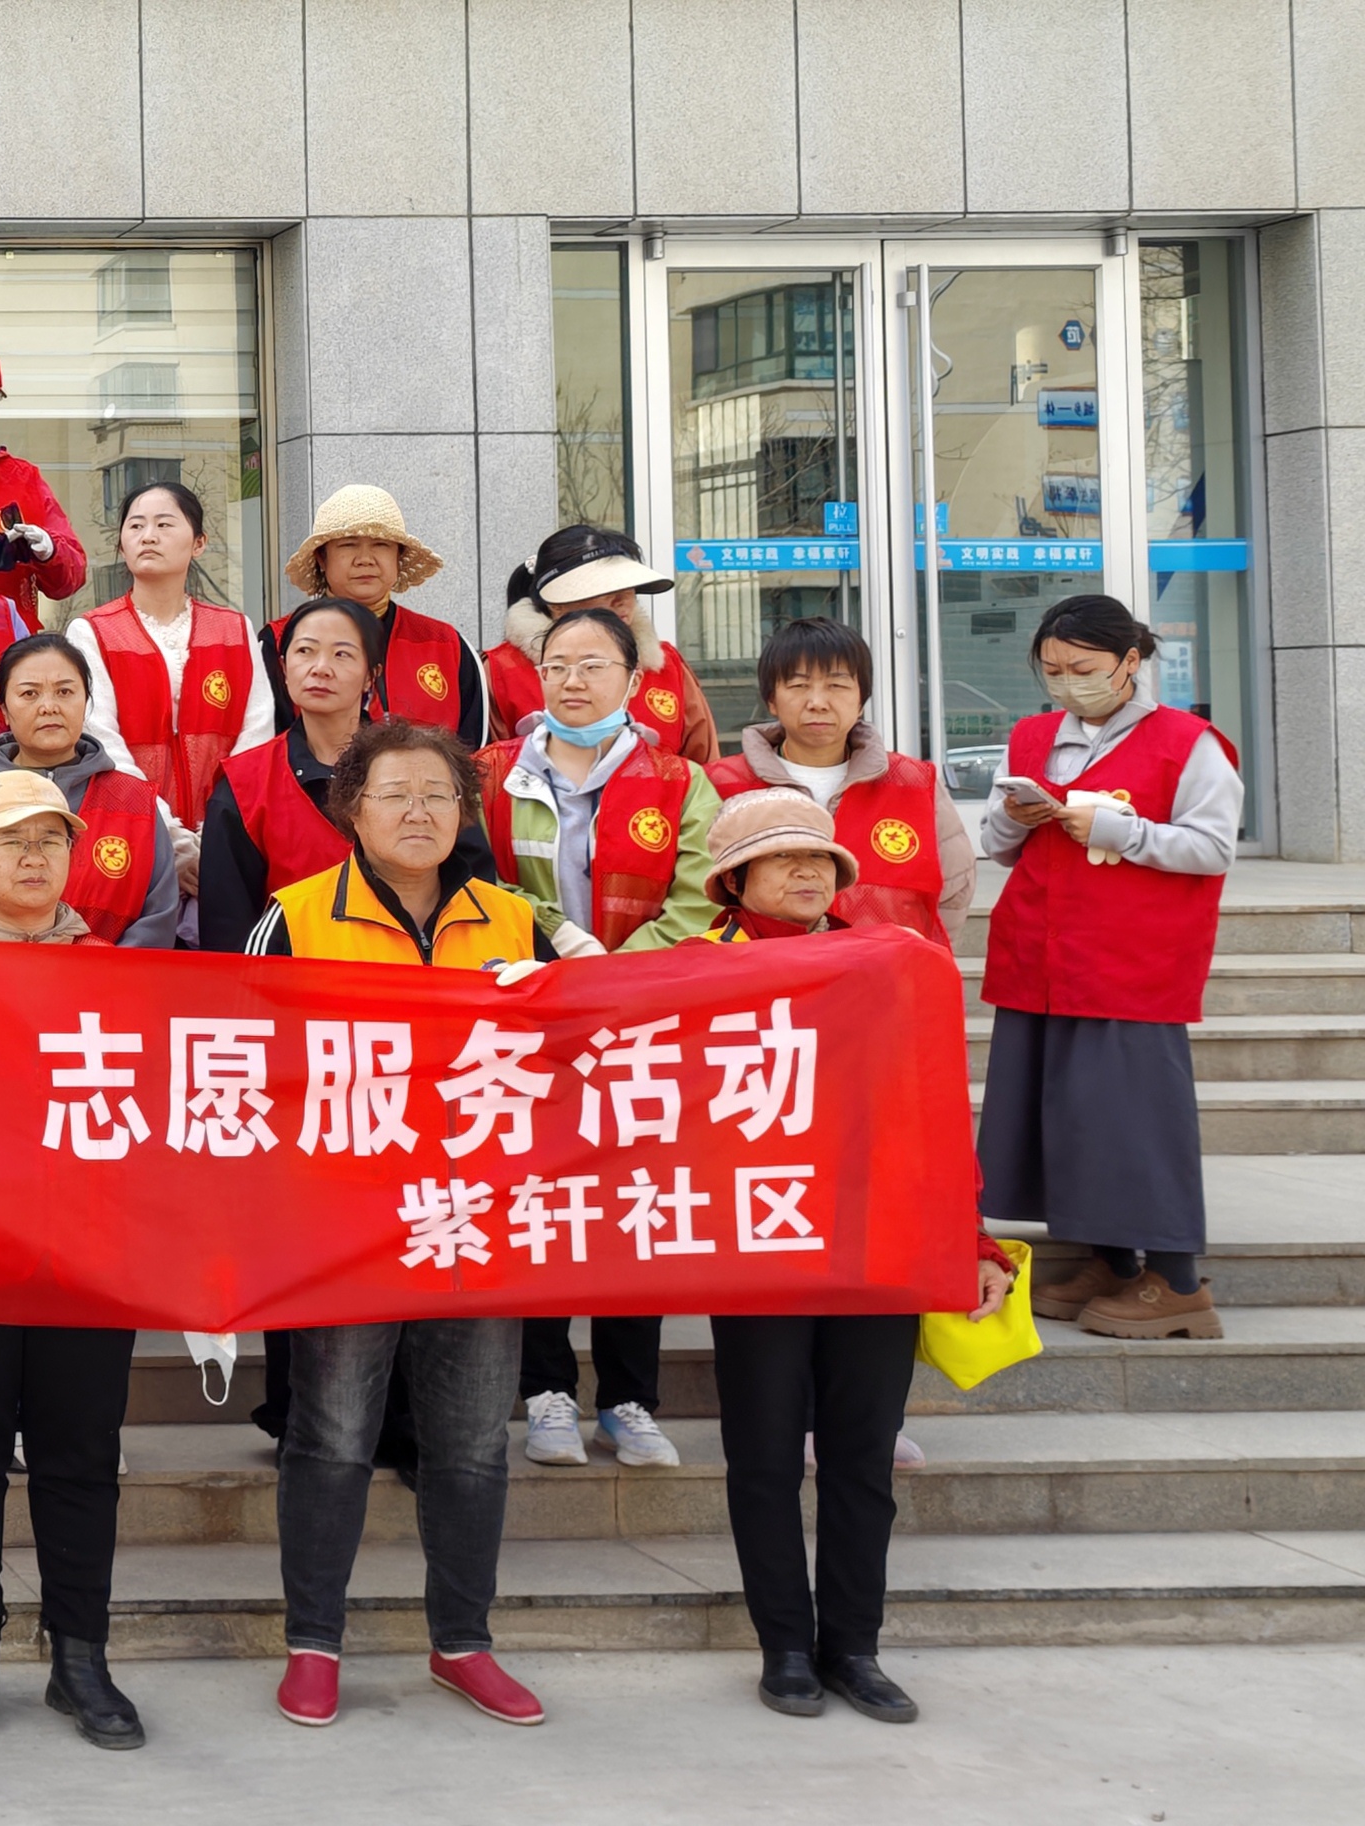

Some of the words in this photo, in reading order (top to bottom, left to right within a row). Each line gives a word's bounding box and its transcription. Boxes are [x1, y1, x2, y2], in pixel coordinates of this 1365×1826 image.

[829, 523, 853, 532] PULL
[721, 547, 778, 560] 文明实践
[792, 547, 850, 560] 幸福紫轩
[961, 547, 1019, 560] 文明实践
[1034, 547, 1092, 560] 幸福紫轩
[396, 1163, 825, 1271] 紫轩社区
